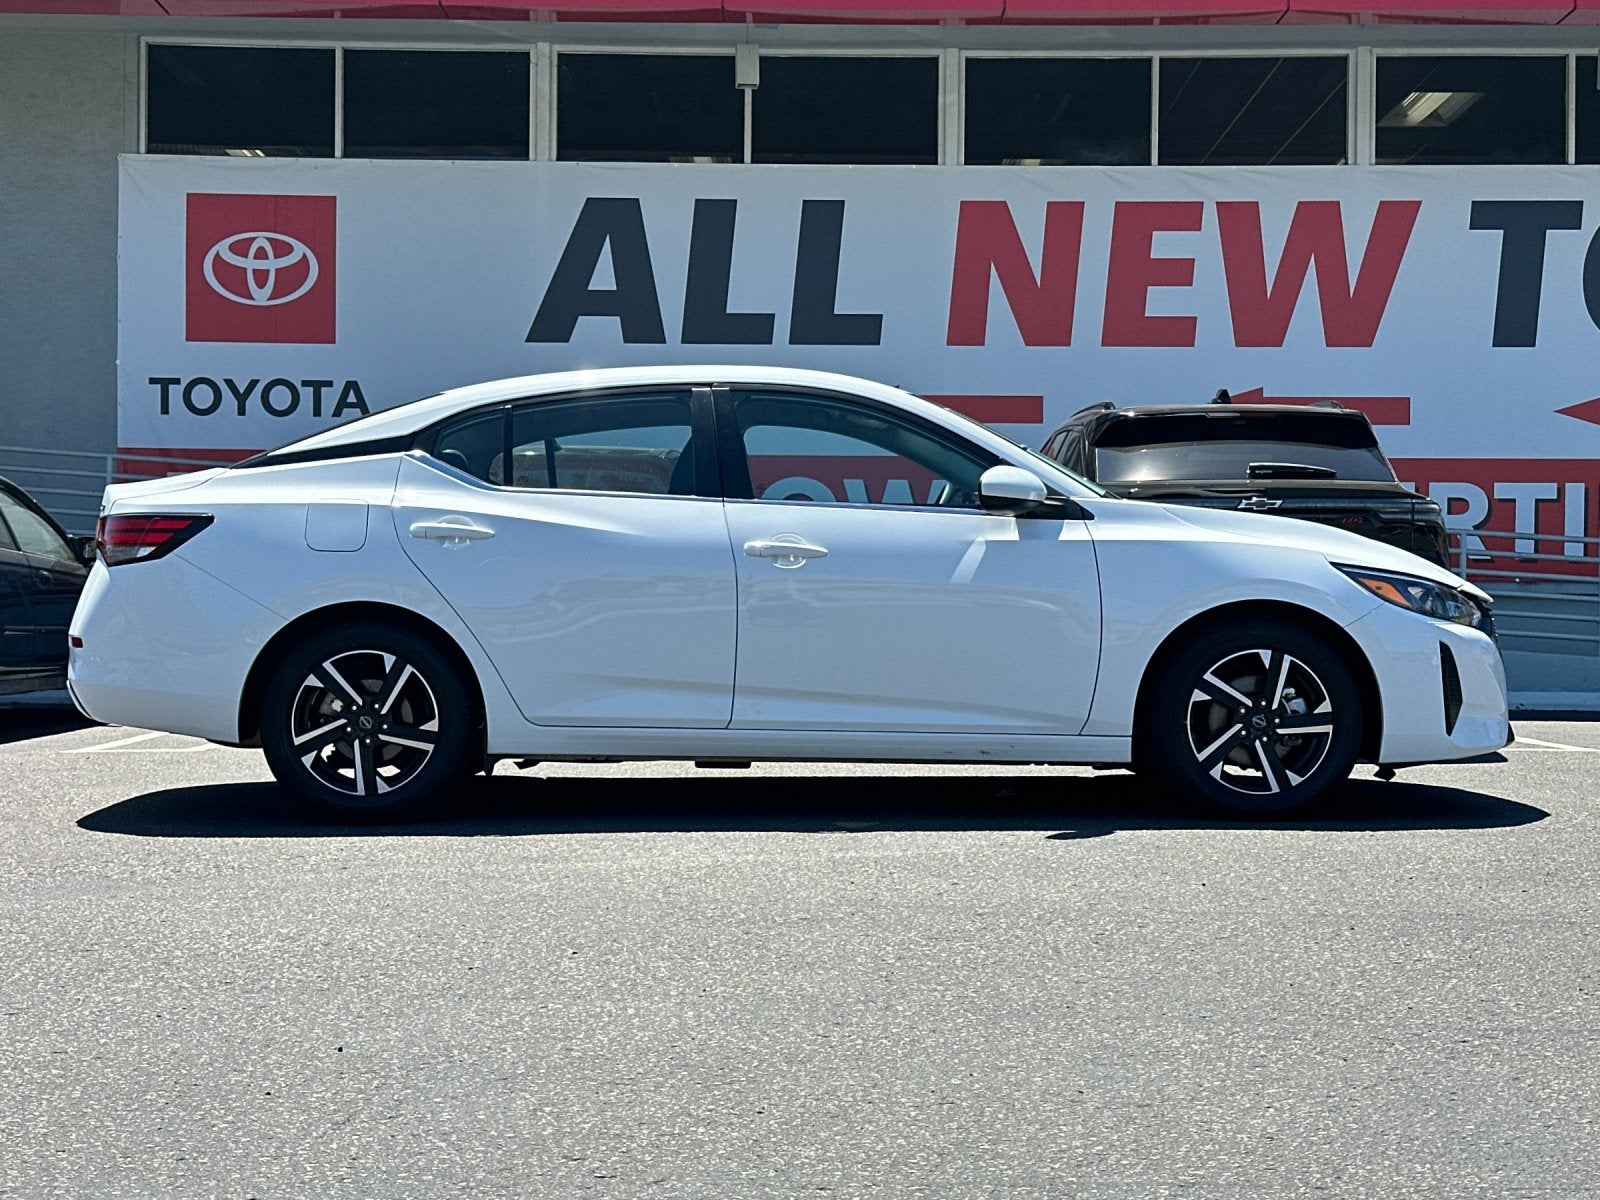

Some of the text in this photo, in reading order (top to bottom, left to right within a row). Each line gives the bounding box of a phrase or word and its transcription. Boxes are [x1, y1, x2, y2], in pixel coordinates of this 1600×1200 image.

[525, 197, 1600, 347] ALL NEW T
[149, 377, 370, 417] TOYOTA
[1400, 482, 1585, 559] RTI
